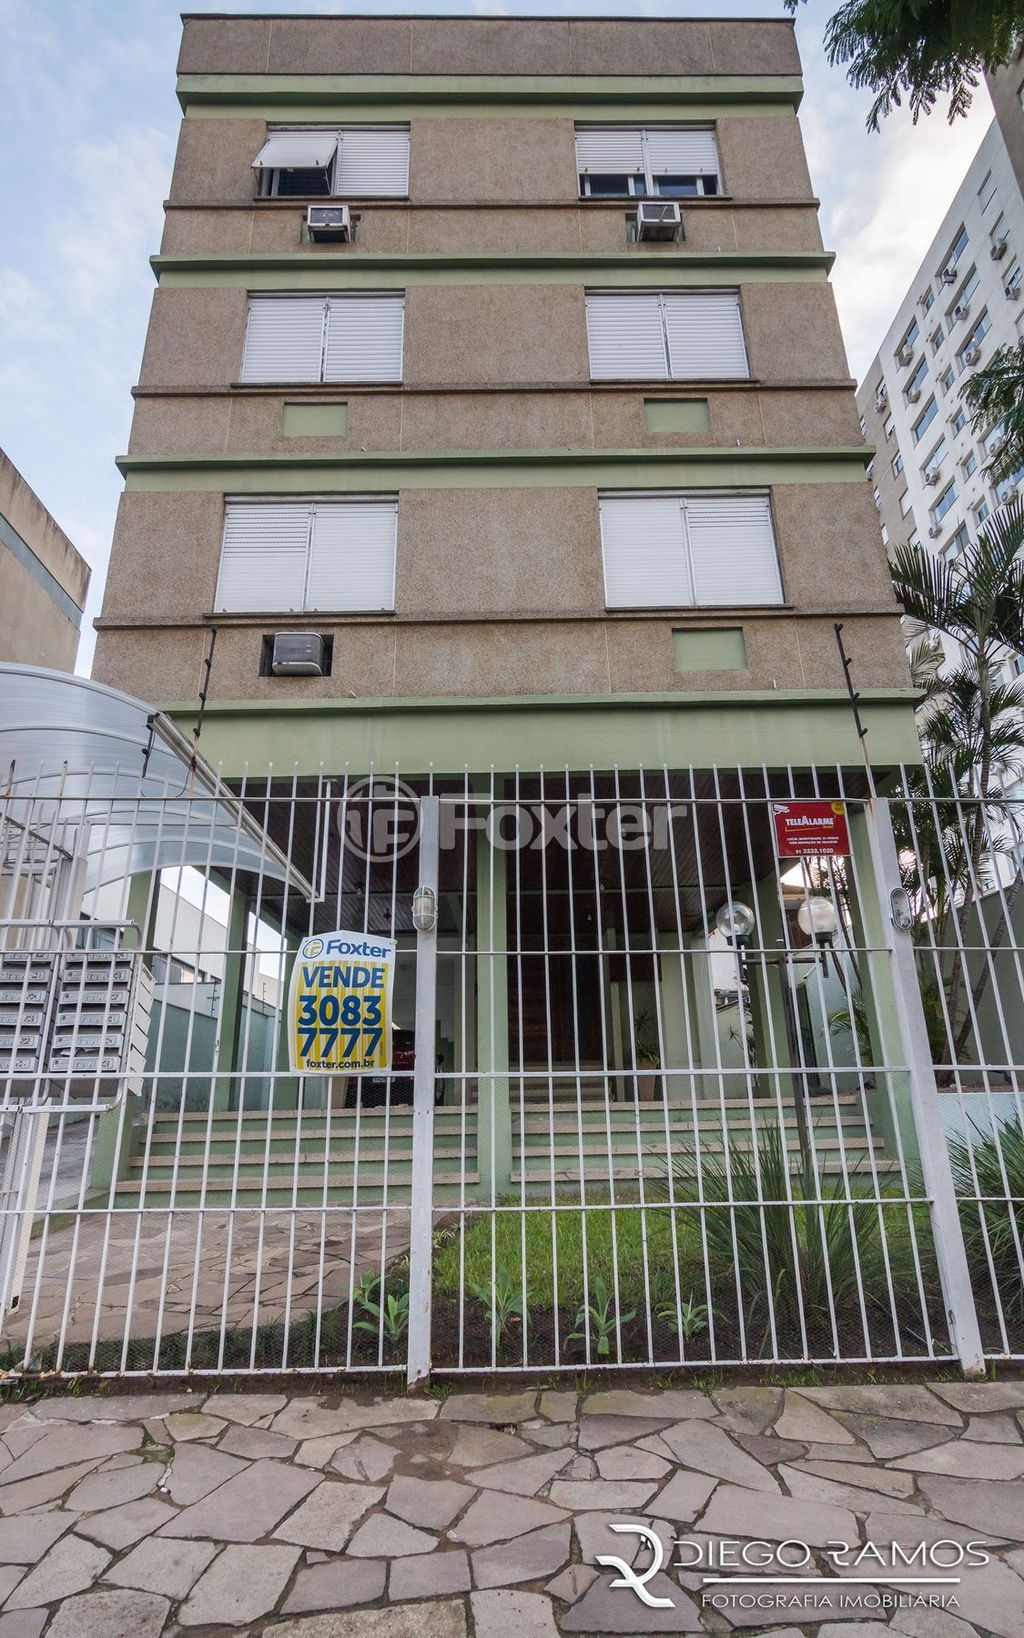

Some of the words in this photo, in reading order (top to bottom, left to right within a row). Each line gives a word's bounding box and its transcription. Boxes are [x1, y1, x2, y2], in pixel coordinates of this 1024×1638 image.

[326, 939, 391, 958] Foxter
[302, 966, 385, 988] VENDE
[298, 995, 382, 1026] 3083
[297, 1028, 383, 1058] 7777
[306, 1059, 375, 1069] foxter.com.br
